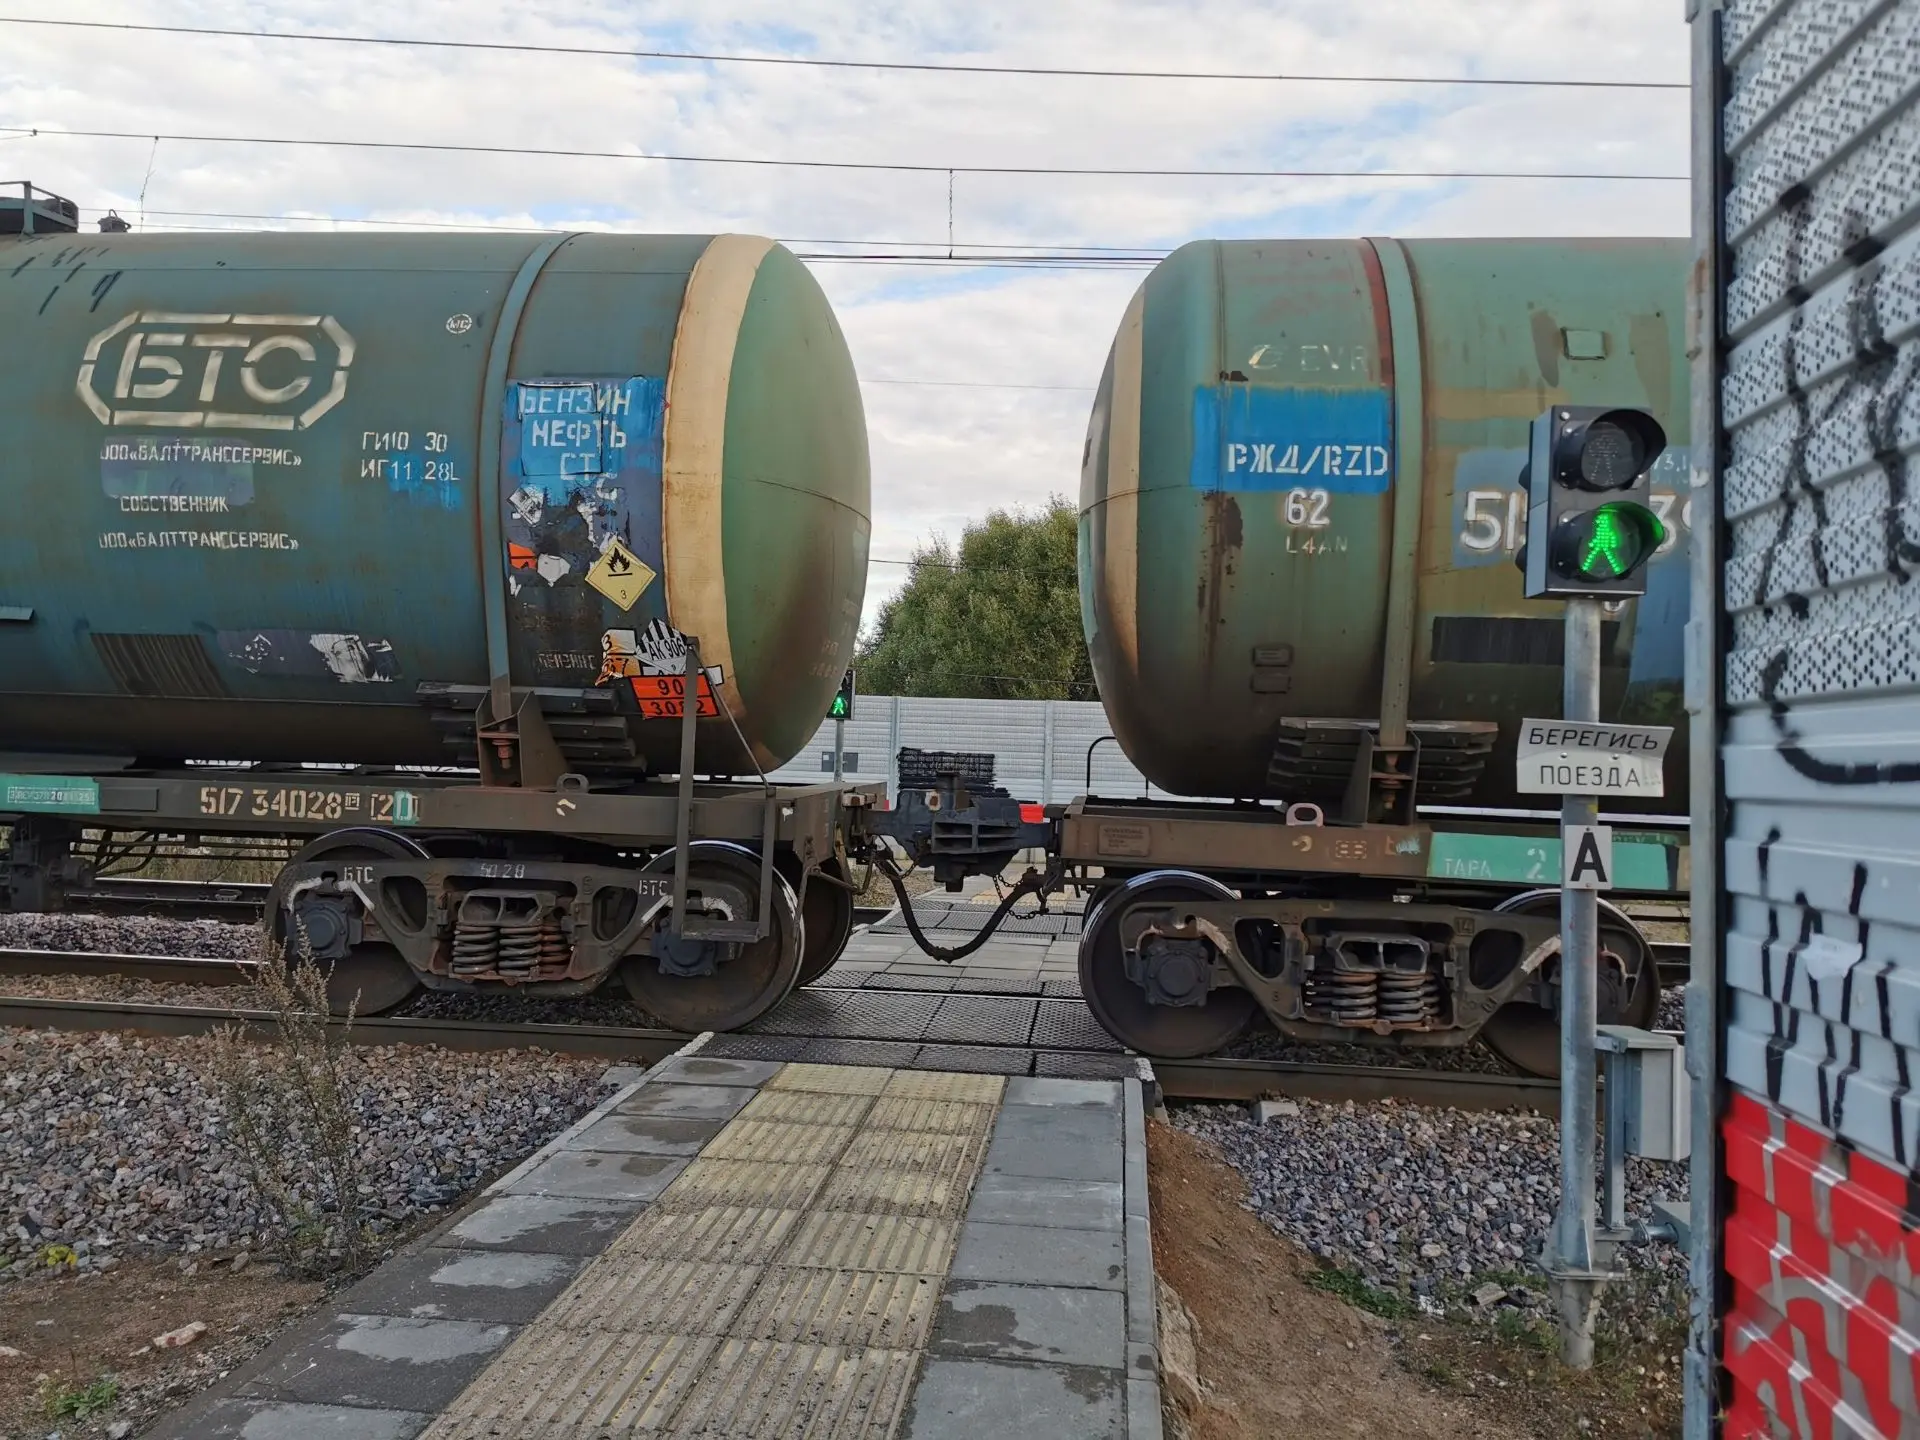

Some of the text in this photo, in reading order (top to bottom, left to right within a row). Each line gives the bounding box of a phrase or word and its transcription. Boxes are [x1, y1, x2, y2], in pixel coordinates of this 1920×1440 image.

[114, 333, 316, 403] БТС
[519, 386, 631, 416] БЕНЗИН
[424, 431, 448, 452] 30
[532, 419, 627, 448] НЕФТЬ
[560, 452, 596, 481] СТ
[120, 496, 229, 512] СОБСТВЕННИК
[1287, 487, 1330, 525] 62
[1461, 491, 1528, 551] 51
[620, 590, 627, 599] 3
[664, 637, 687, 657] 906
[657, 679, 684, 696] 90
[1529, 728, 1658, 750] БЕРЕГИСЬ
[1540, 765, 1641, 788] ПОЕЗДА
[200, 787, 244, 815] 517
[251, 789, 342, 820] 34028
[344, 866, 373, 884] БТС
[1444, 858, 1492, 879] ТАРА
[639, 880, 668, 896] БТС
